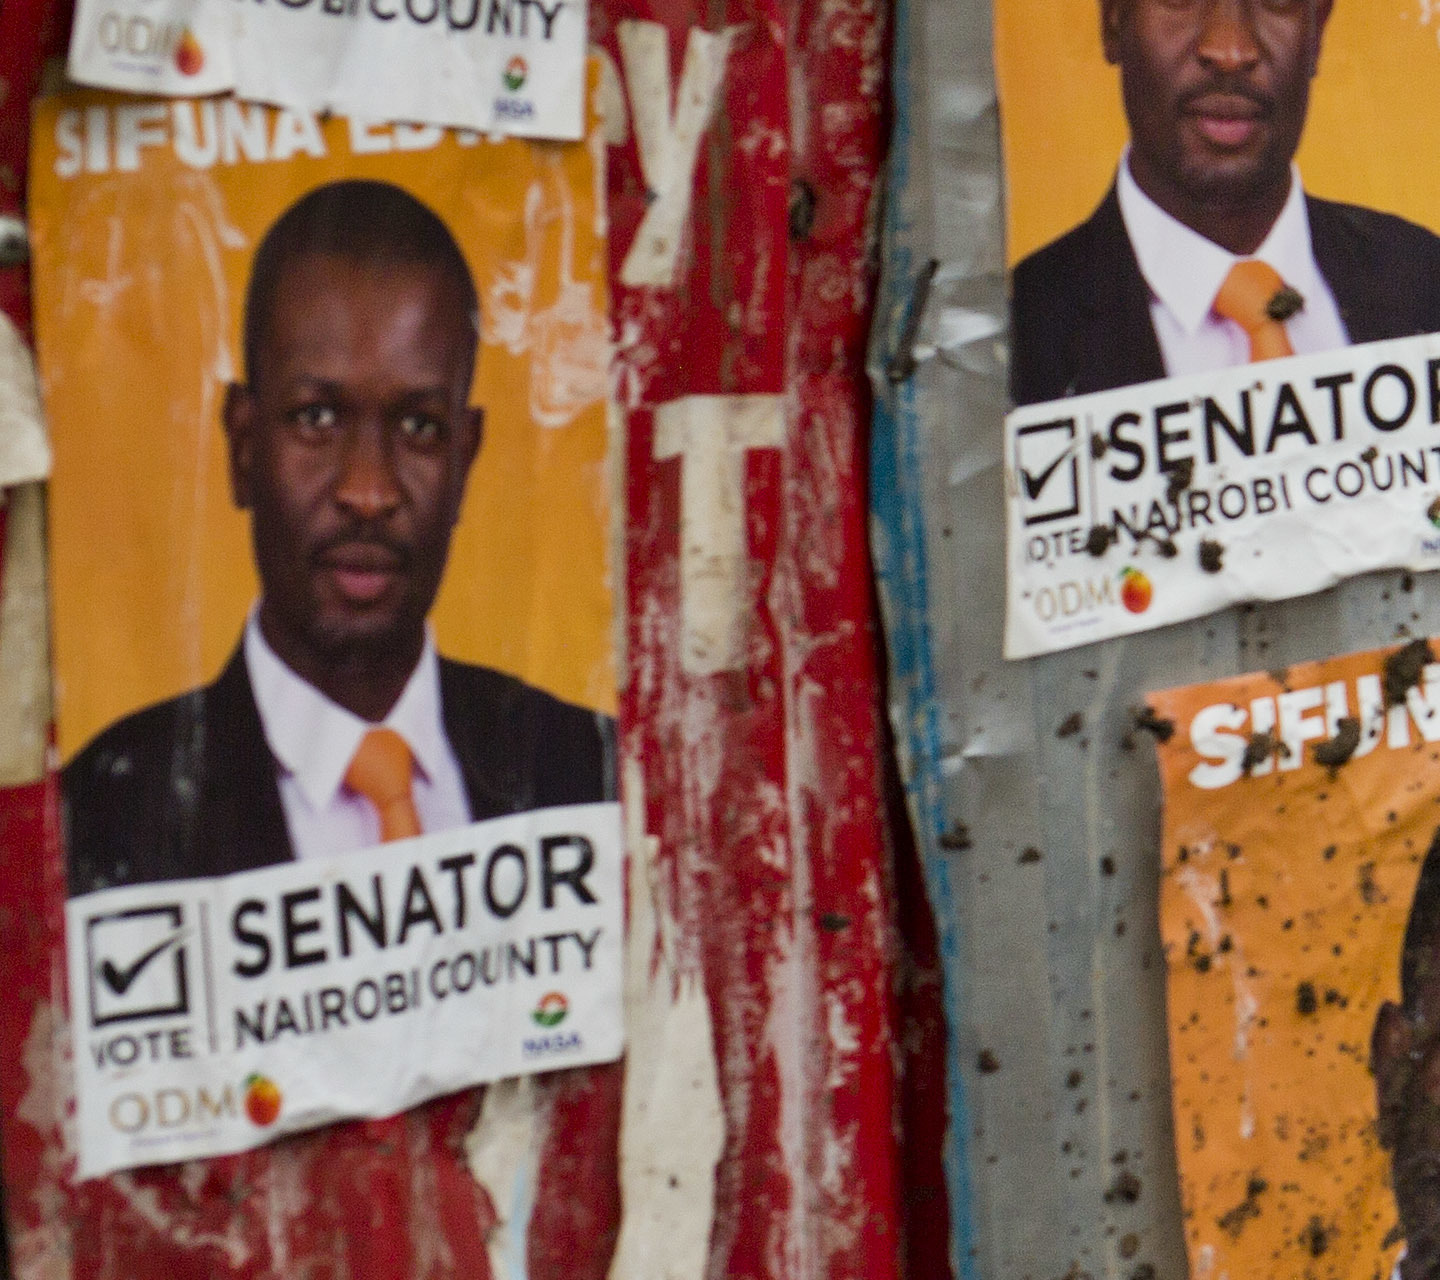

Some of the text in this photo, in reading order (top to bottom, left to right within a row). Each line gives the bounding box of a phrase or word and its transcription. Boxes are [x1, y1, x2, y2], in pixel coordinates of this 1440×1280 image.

[53, 105, 330, 177] SIFUNA
[1112, 478, 1291, 545] NAIROBI
[1033, 578, 1117, 624] ODM
[231, 832, 600, 981] SENATOR
[232, 972, 422, 1052] NAIROBI
[430, 928, 606, 1003] COUNTY
[109, 1082, 243, 1135] ODM
